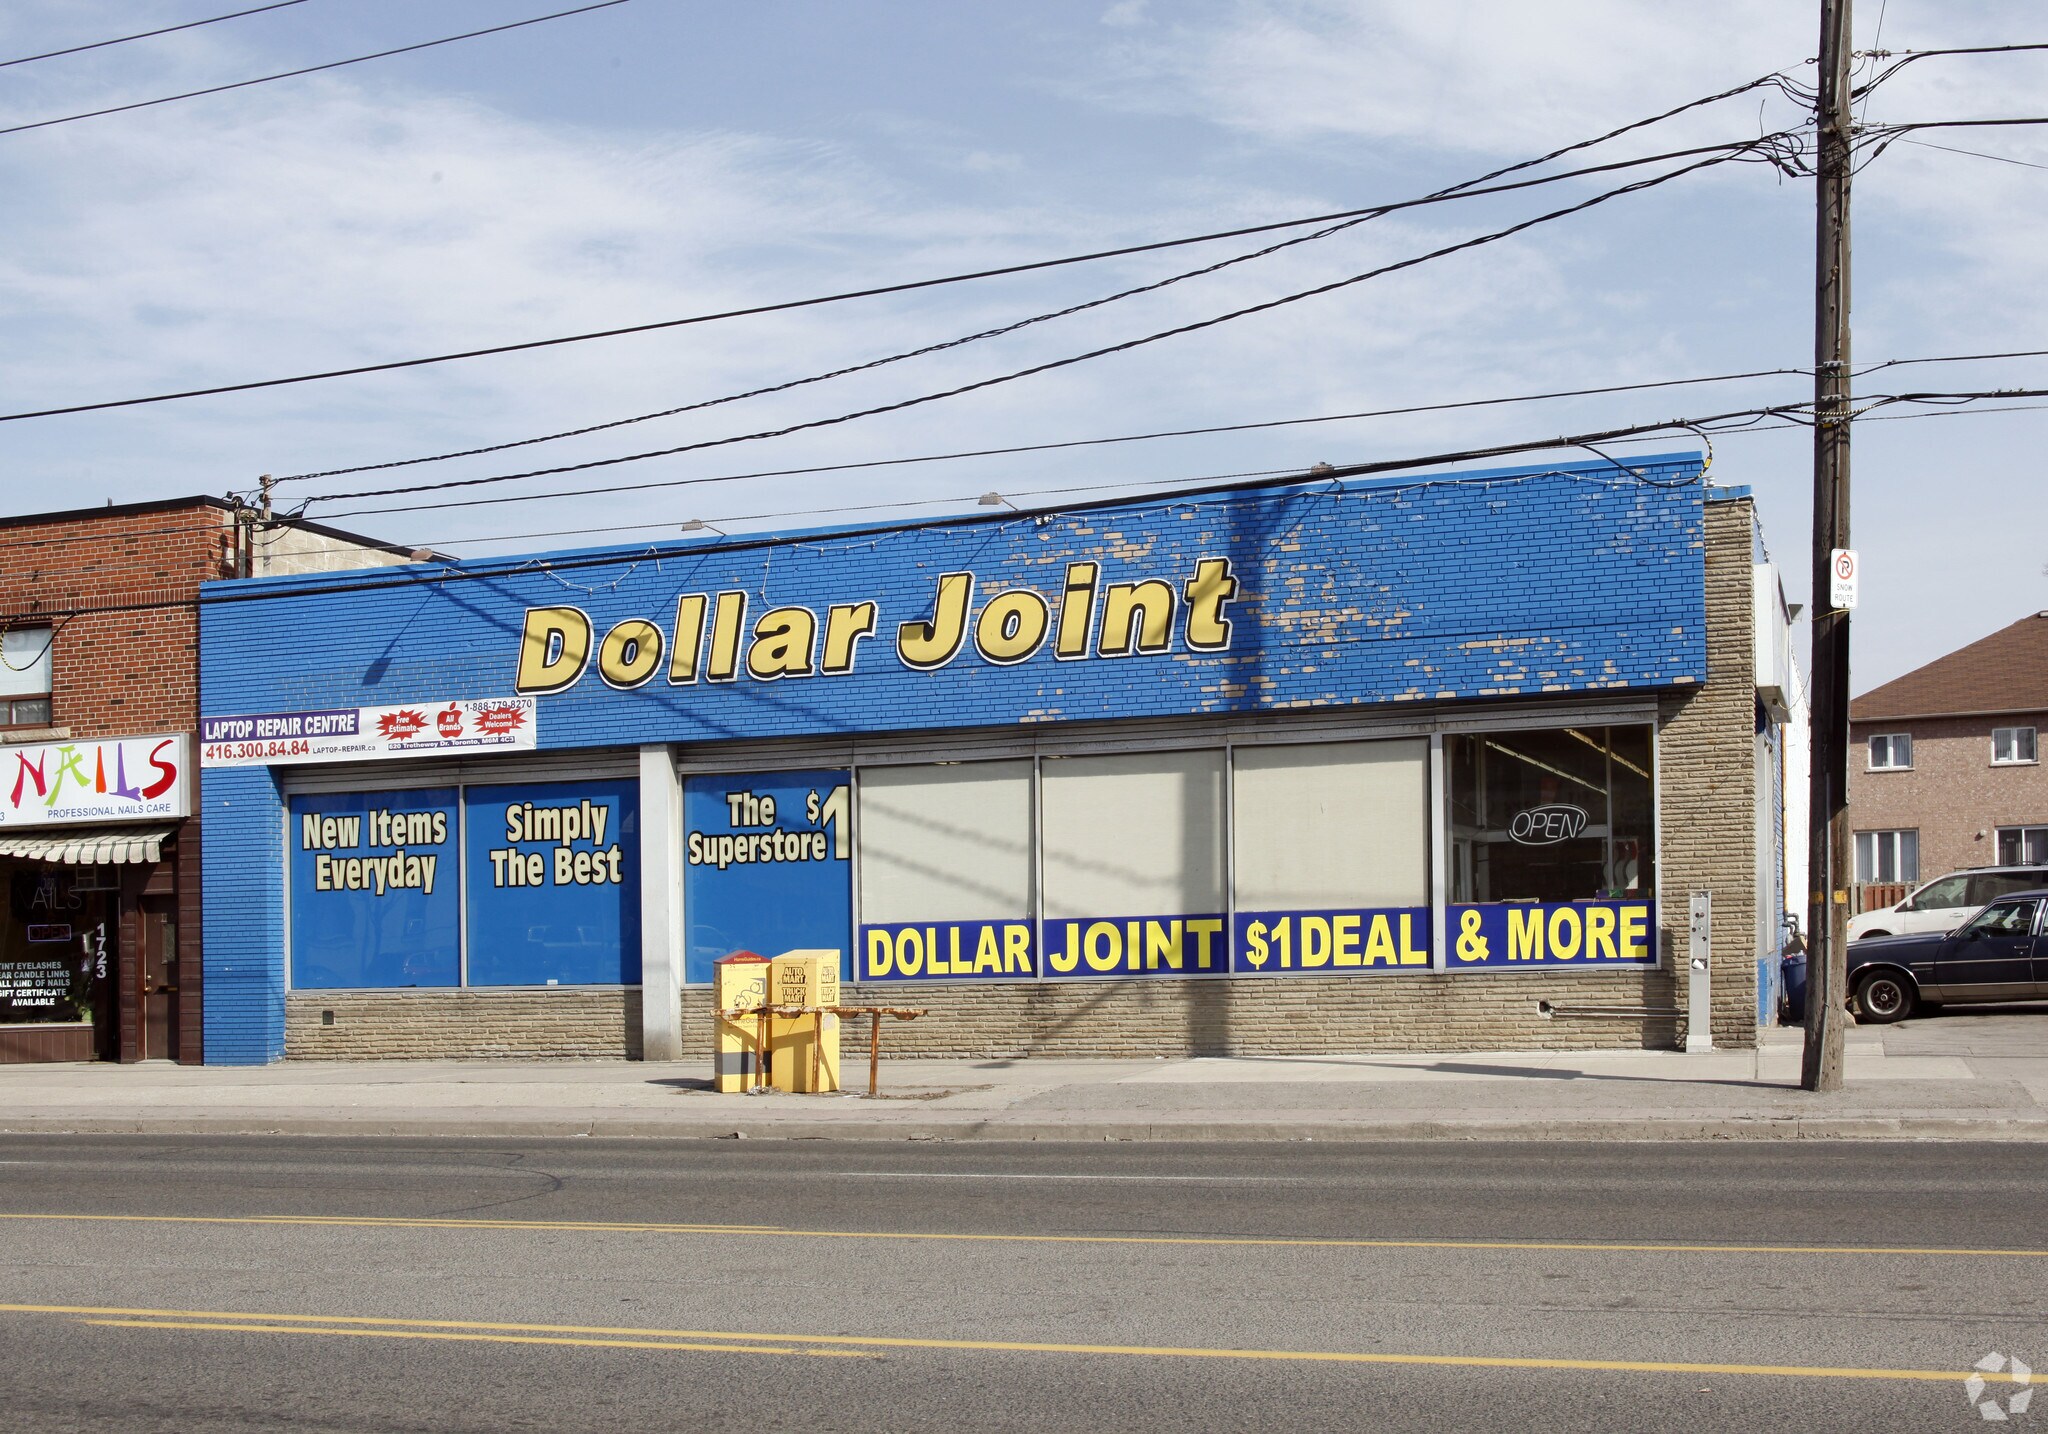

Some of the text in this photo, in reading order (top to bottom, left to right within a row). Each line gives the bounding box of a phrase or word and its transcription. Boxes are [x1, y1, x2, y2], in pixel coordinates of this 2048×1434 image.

[1836, 583, 1853, 591] SNOW
[1834, 594, 1854, 602] ROUTE
[514, 556, 1240, 696] Dollar Joint
[395, 716, 410, 724] Free
[445, 714, 455, 723] All
[488, 712, 512, 720] Dealers
[205, 714, 356, 740] LAPTOP REPAIR CENTRE
[388, 724, 417, 733] Estimate
[438, 722, 461, 732] Brands
[484, 719, 513, 728] Welcome
[205, 739, 376, 760] 416.300.84.84 LAPTOP-REPAIR.ca
[10, 739, 177, 809] NAILS
[47, 807, 115, 819] PROFESSIONAL
[117, 804, 144, 815] NAILS
[146, 803, 171, 813] CARE
[726, 790, 776, 828] The
[505, 798, 608, 847] Simply
[1511, 811, 1581, 839] OPEN
[302, 808, 447, 850] New Items
[687, 827, 828, 871] Superstore
[489, 843, 624, 888] The Best
[315, 848, 438, 896] Everyday
[29, 926, 70, 940] OPEN
[867, 924, 1033, 977] DOLLAR
[1049, 918, 1222, 973] JOINT
[1456, 909, 1490, 962] &
[1507, 905, 1649, 961] MORE
[96, 922, 108, 979] 1723
[16, 961, 62, 970] EYELASHES
[14, 970, 45, 979] CANDLE
[46, 970, 71, 978] LINKS
[784, 967, 804, 976] AUTO
[13, 979, 33, 988] KIND
[35, 979, 46, 987] OF
[47, 978, 71, 987] NAILS
[782, 975, 805, 984] MART
[16, 988, 67, 997] CERTIFICATE
[782, 987, 806, 996] TRUCK
[12, 998, 56, 1007] AVAILABLE
[783, 995, 804, 1003] MART
